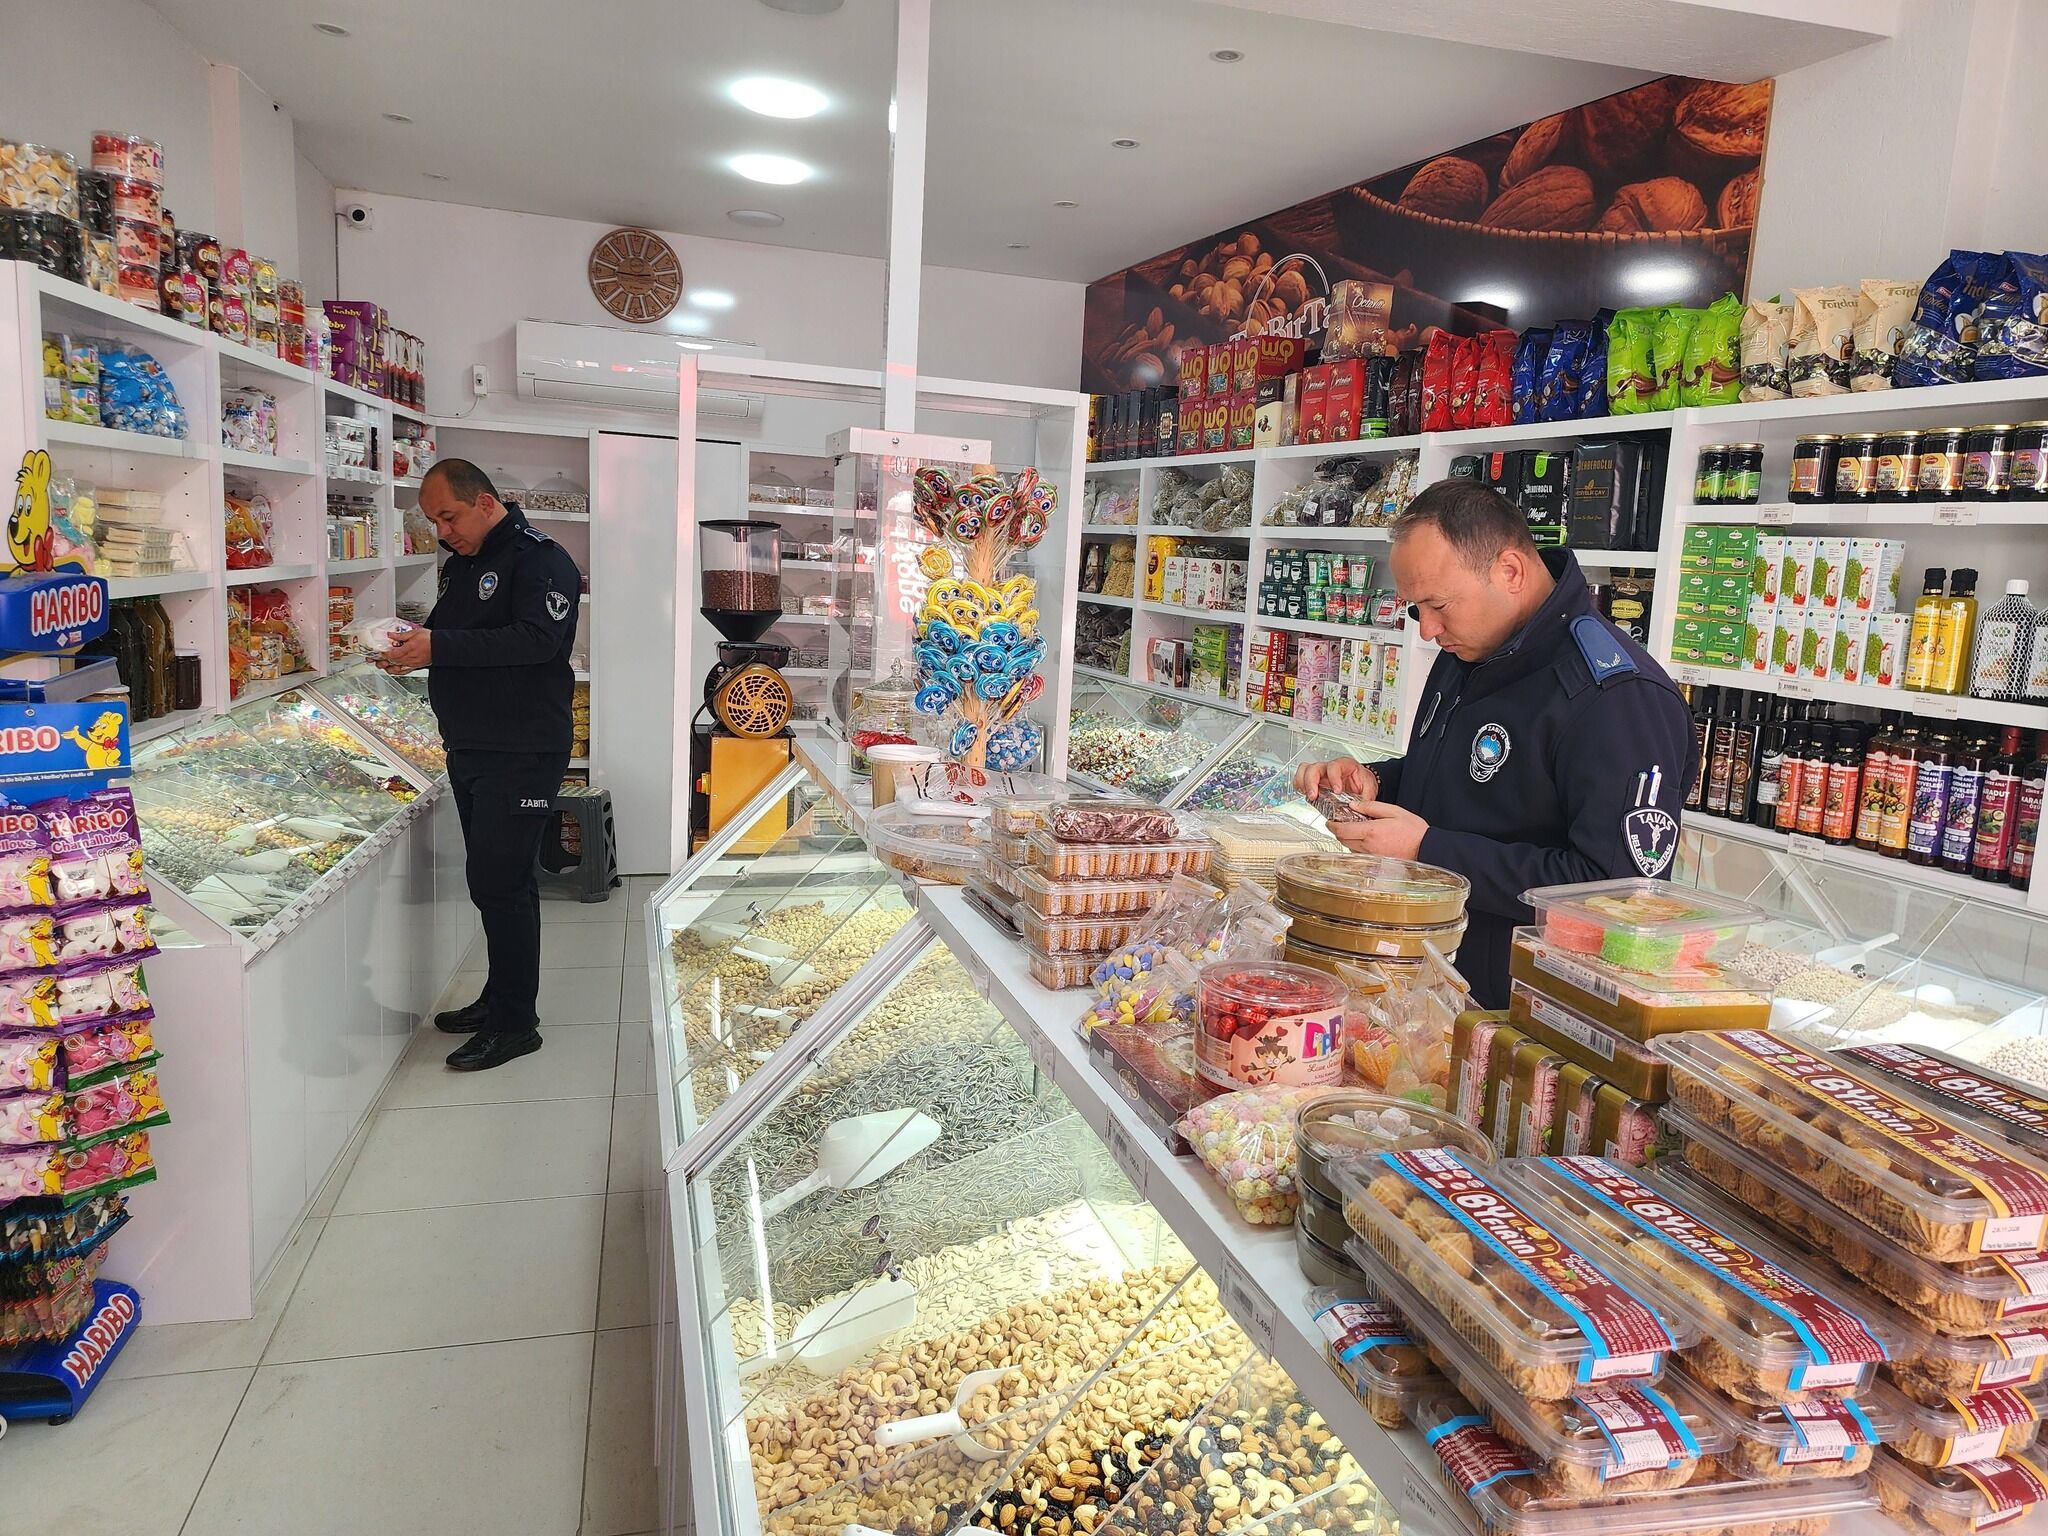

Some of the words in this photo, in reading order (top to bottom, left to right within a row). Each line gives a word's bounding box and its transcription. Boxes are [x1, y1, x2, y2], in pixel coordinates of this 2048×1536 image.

[32, 582, 102, 637] HARIBO
[0, 726, 60, 754] IBO
[520, 798, 548, 808] ZABITA
[1983, 789, 2010, 798] ARADUT
[2021, 796, 2042, 805] KARA
[0, 814, 38, 835] IBO
[1637, 812, 1672, 830] TAVAS
[0, 840, 36, 851] llows
[52, 832, 129, 854] Chamallows
[62, 1292, 136, 1390] HARIBO
